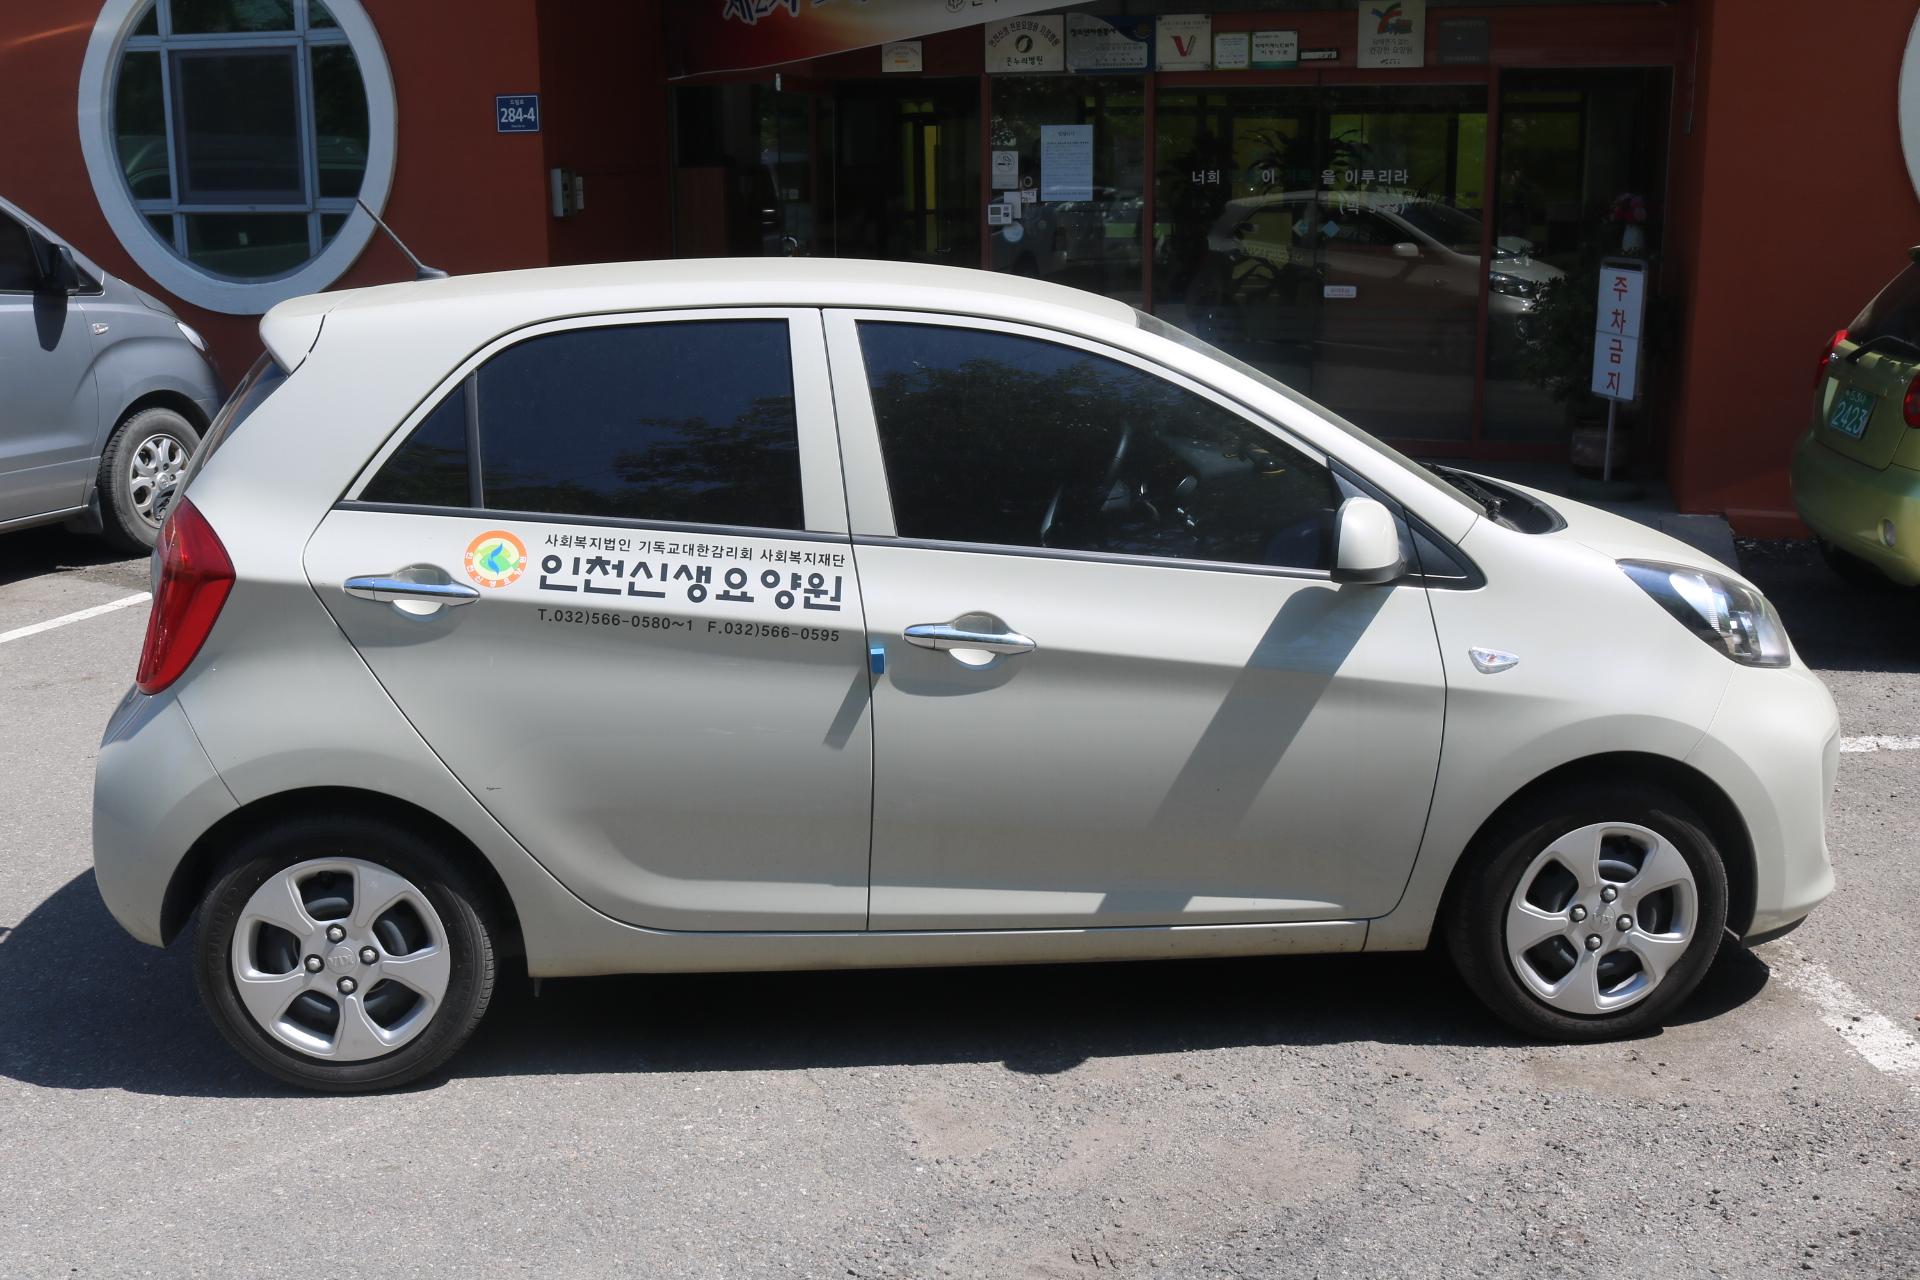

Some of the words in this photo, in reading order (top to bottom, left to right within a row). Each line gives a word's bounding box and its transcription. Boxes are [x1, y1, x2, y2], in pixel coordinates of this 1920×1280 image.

[500, 106, 536, 123] 284-4
[1192, 169, 1220, 185] 너희
[1345, 168, 1409, 185] 이루리라
[1605, 275, 1628, 396] 주차금지
[1831, 400, 1868, 434] 2423
[545, 534, 631, 552] 사회복지법인
[639, 541, 753, 561] 기독교대한감리회
[760, 549, 846, 567] 사회복지재단
[539, 554, 842, 612] 인천신생요양원
[537, 608, 693, 631] T.032)566-0580~1
[707, 621, 840, 642] F.032)566-0595
